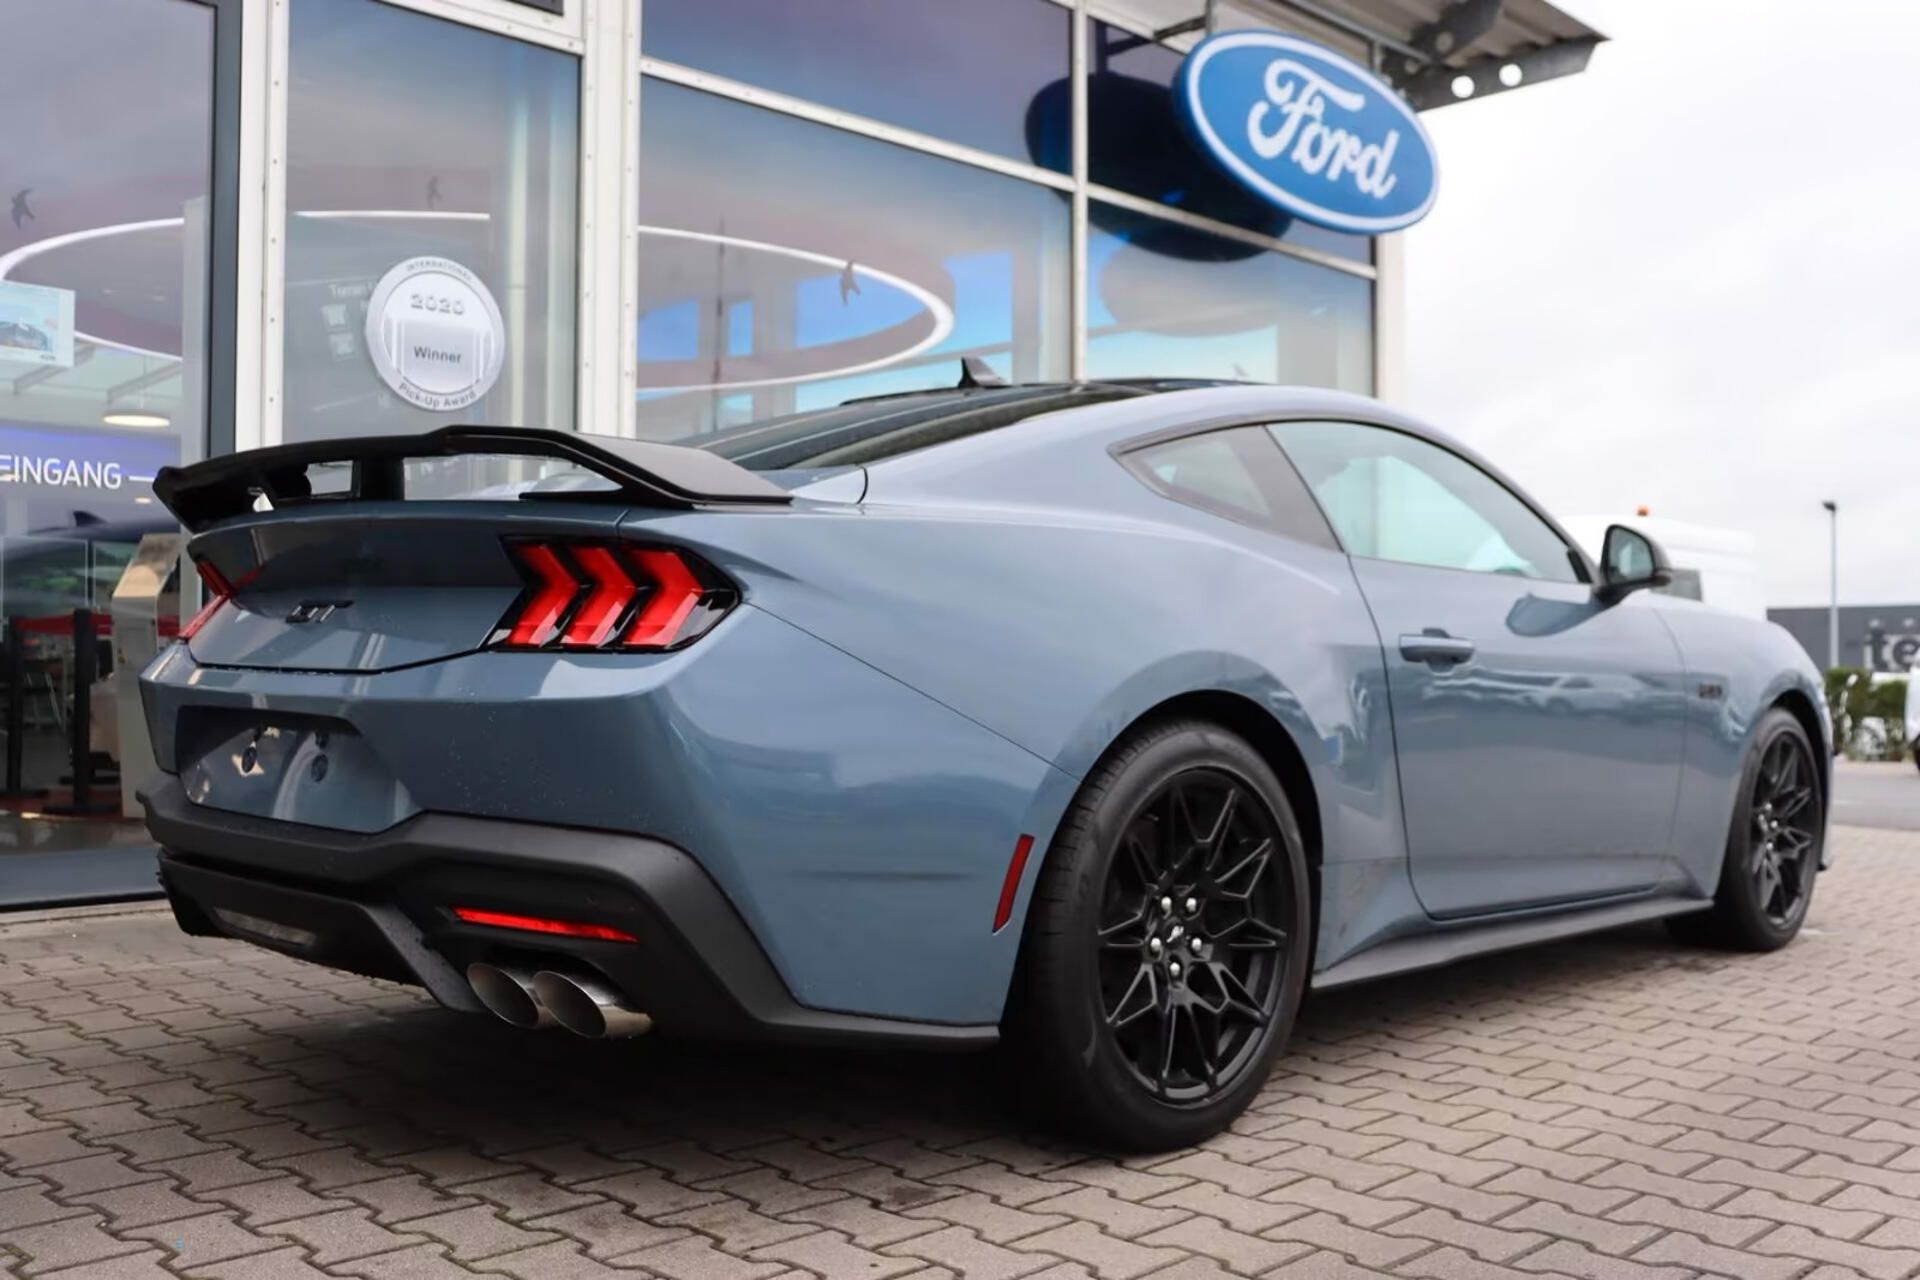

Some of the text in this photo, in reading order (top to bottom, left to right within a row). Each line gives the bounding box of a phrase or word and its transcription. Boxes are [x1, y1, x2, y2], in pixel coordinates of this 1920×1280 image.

[1247, 58, 1401, 200] Ford
[410, 293, 465, 316] 2020
[413, 346, 463, 364] Winner
[398, 382, 477, 409] Pick-Up Award
[0, 454, 122, 490] EINGANG
